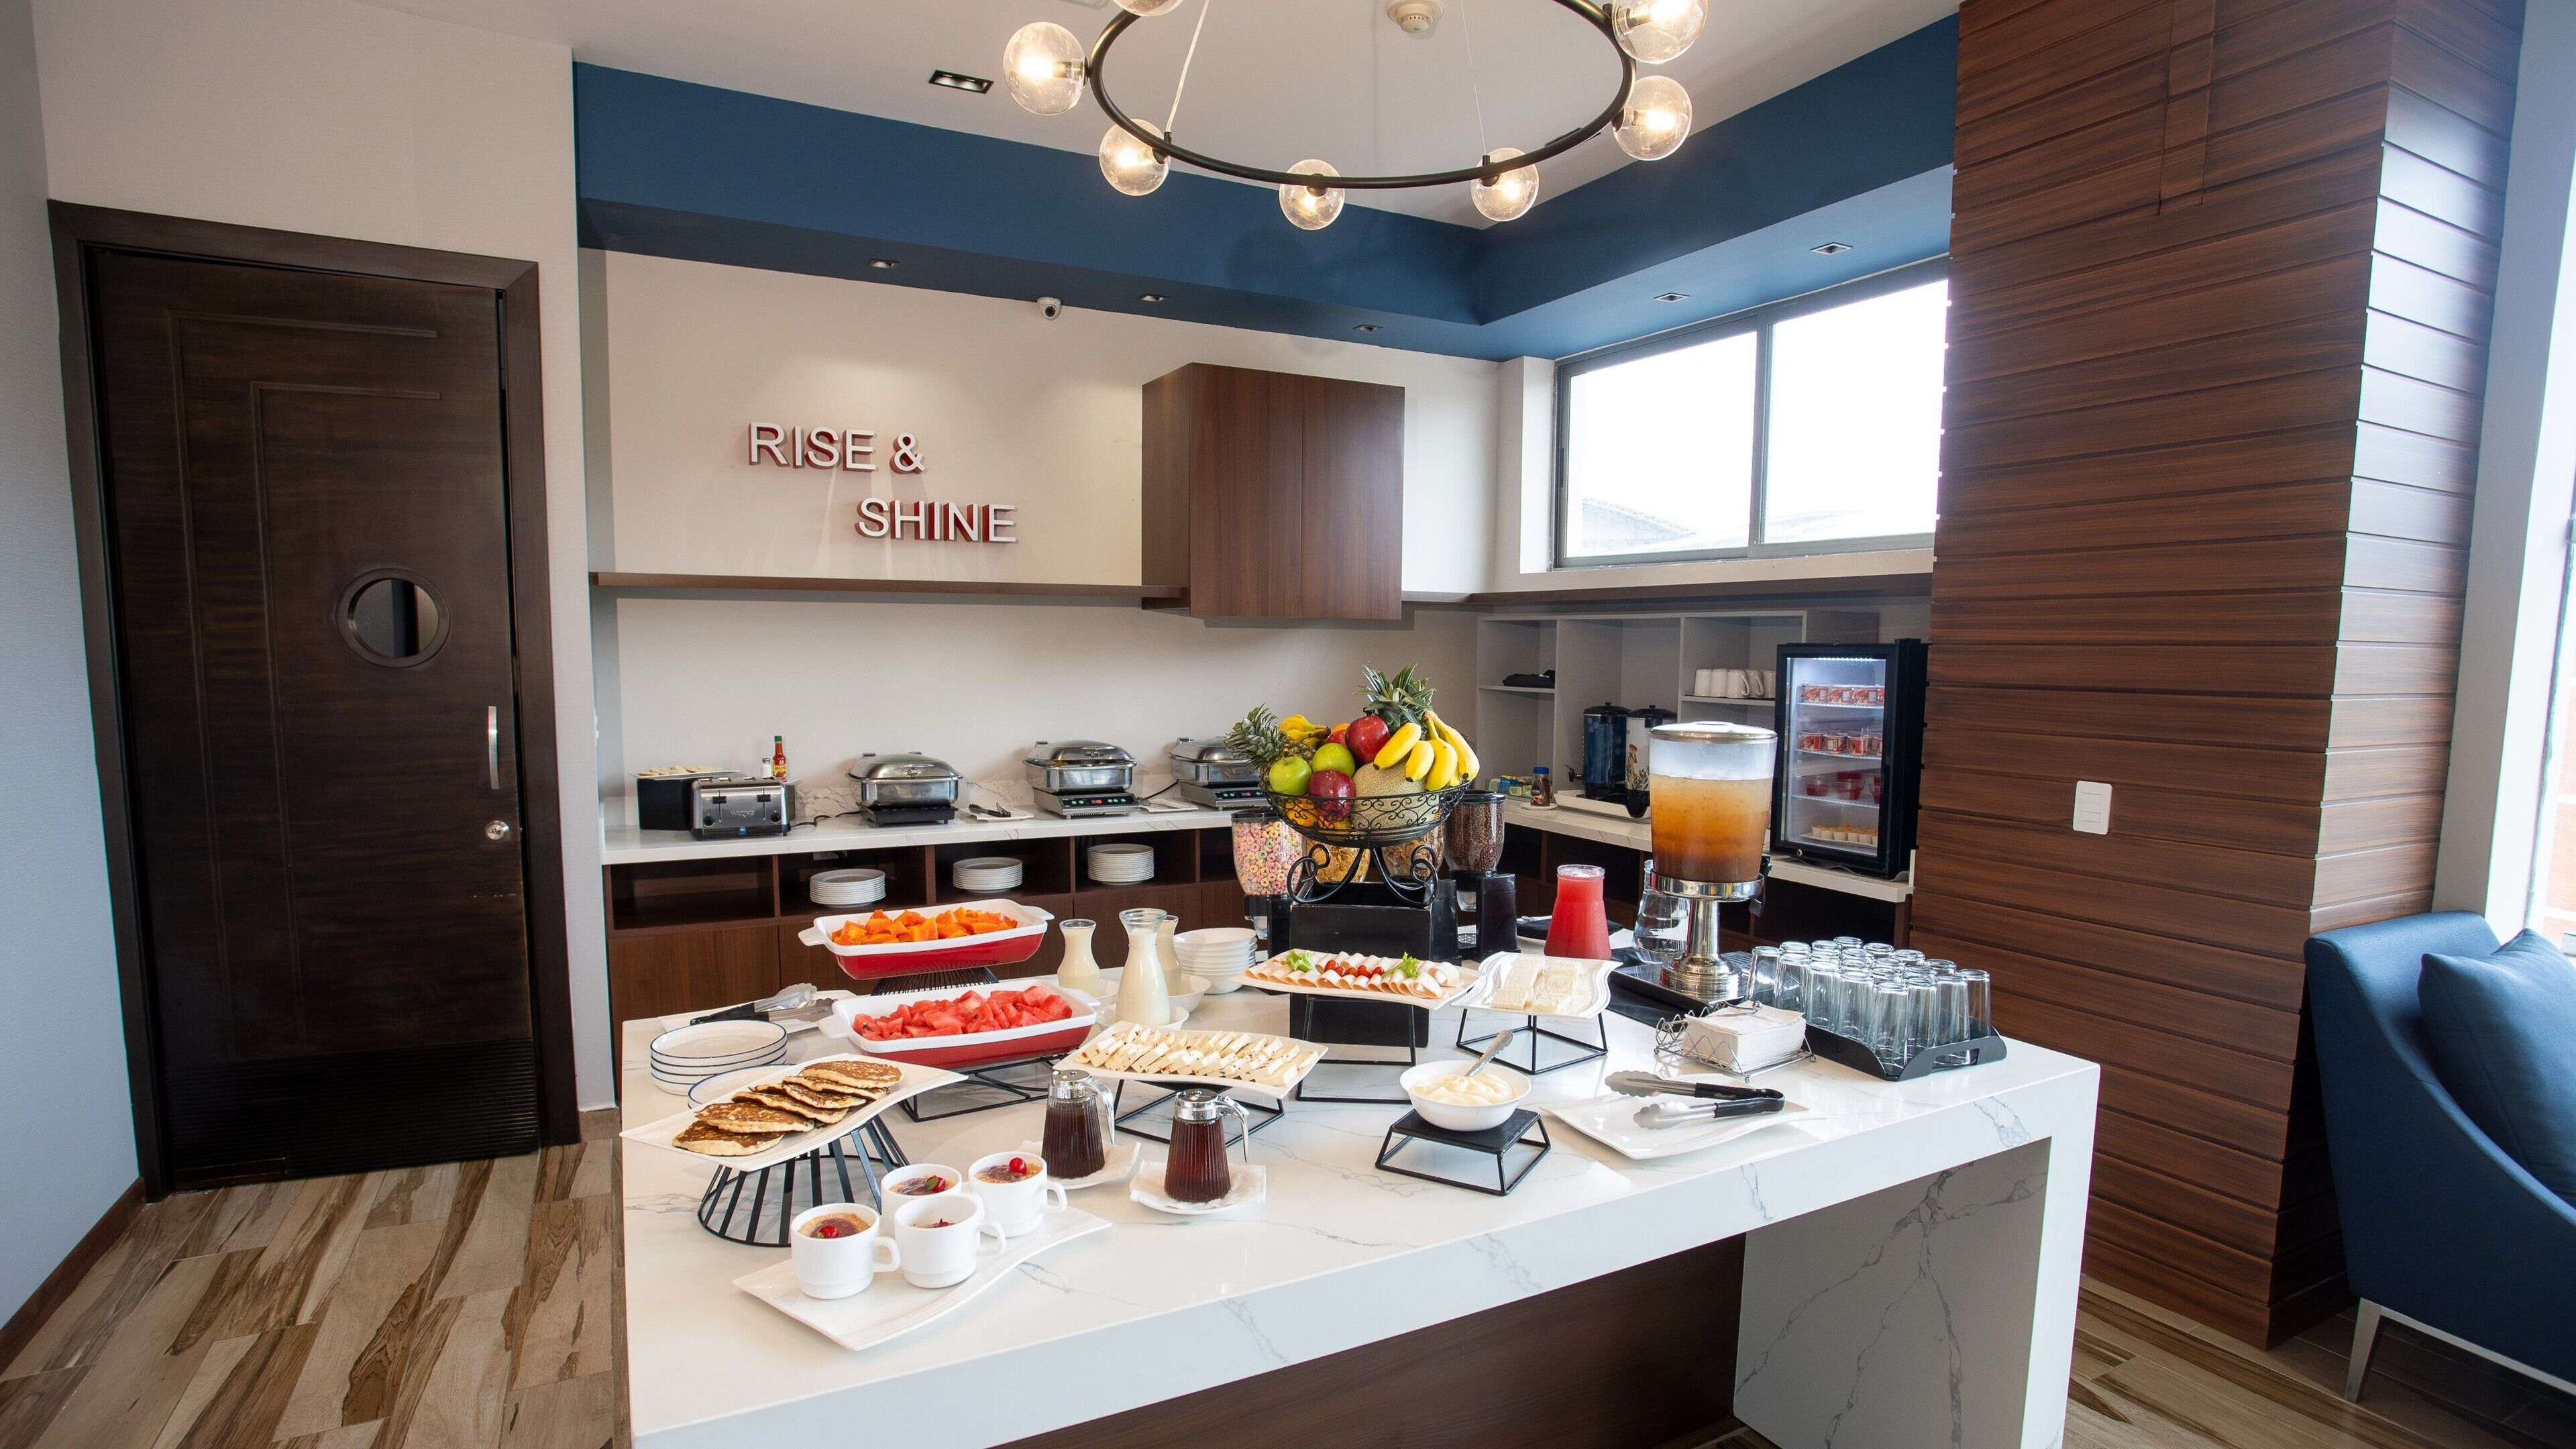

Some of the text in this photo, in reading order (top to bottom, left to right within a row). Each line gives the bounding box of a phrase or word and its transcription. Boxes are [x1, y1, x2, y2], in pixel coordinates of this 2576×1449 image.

[749, 421, 926, 473] RISE &
[856, 498, 1017, 543] SHINE
